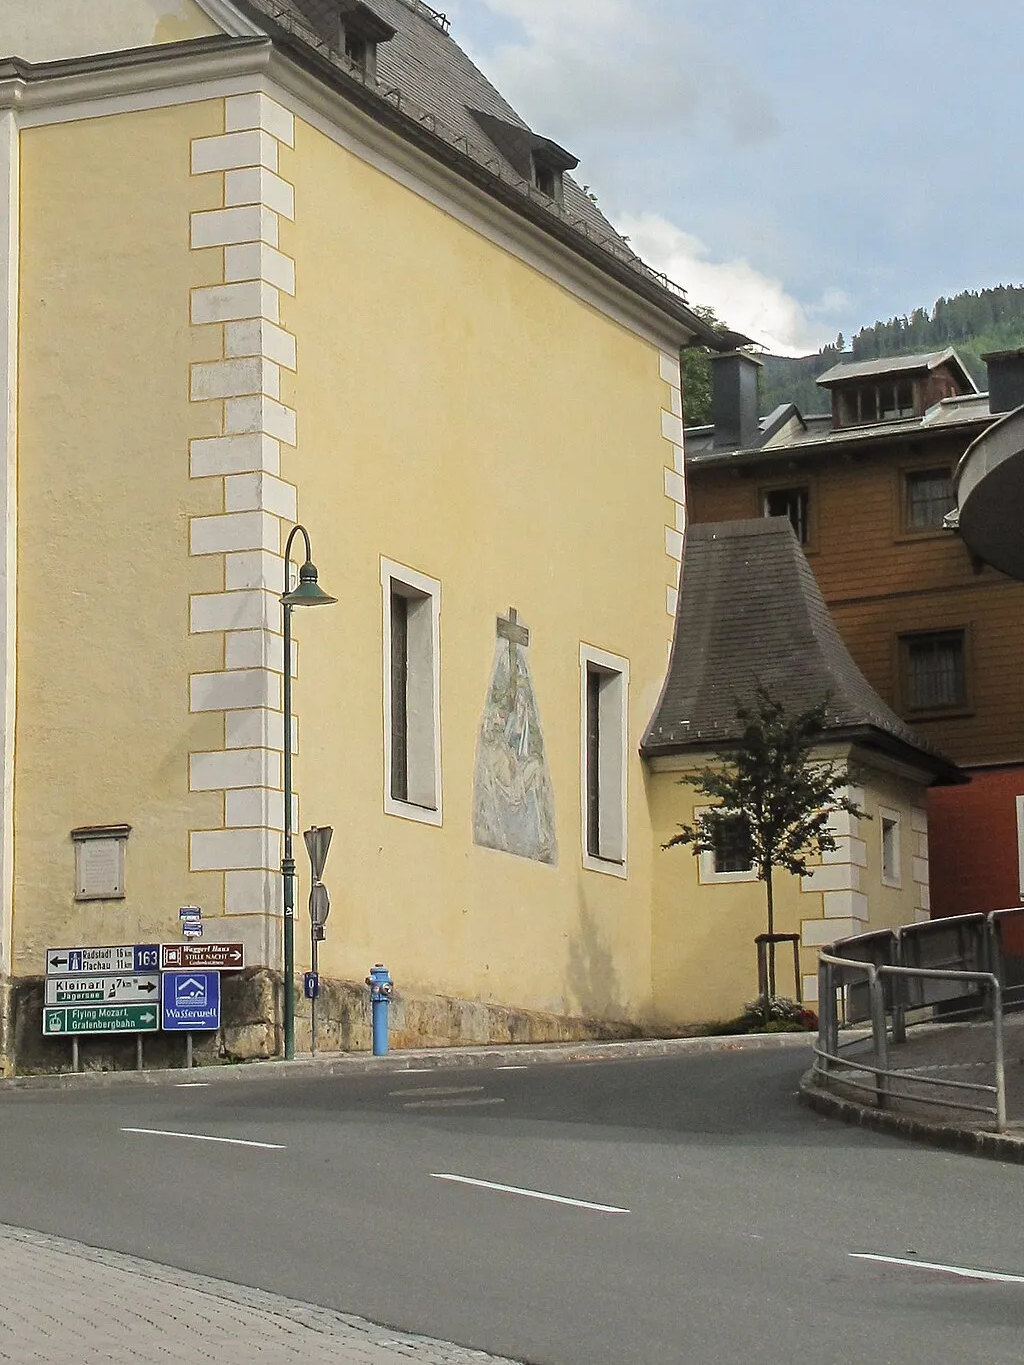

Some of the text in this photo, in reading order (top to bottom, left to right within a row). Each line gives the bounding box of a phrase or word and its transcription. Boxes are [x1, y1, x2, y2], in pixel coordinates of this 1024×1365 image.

[82, 948, 112, 959] Radstadt
[116, 948, 124, 958] 16
[137, 950, 158, 966] 163
[82, 960, 132, 970] Flachau 11 km
[56, 979, 105, 991] Kleinarl
[116, 979, 122, 988] 7
[122, 980, 132, 988] km
[61, 992, 100, 1001] Jägersee
[72, 1009, 96, 1020] Flying
[165, 1007, 217, 1019] Wasserwelt
[72, 1018, 136, 1031] Grafenbergbahn
